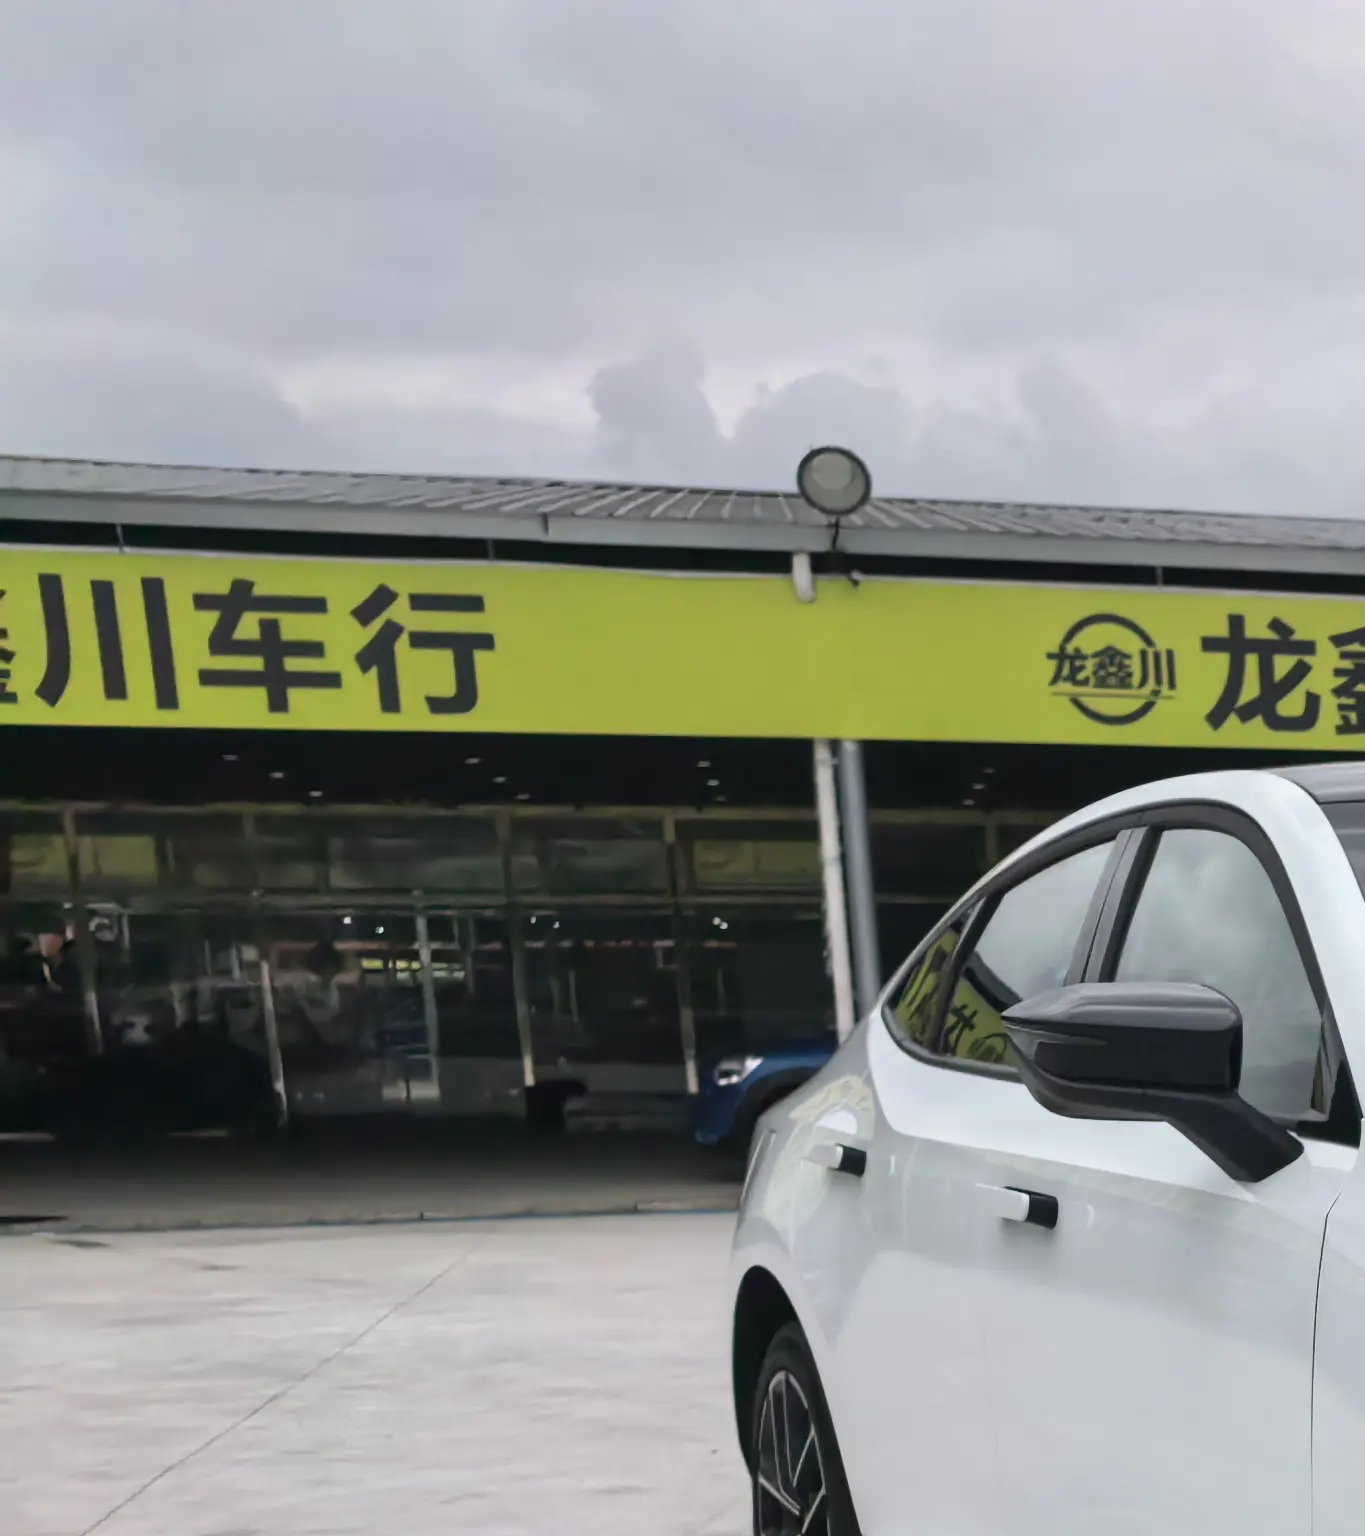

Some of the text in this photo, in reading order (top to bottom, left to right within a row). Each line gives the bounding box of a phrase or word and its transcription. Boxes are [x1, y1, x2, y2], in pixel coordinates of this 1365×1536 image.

[0, 573, 495, 714] 川车行
[1046, 645, 1176, 691] 龙鑫川
